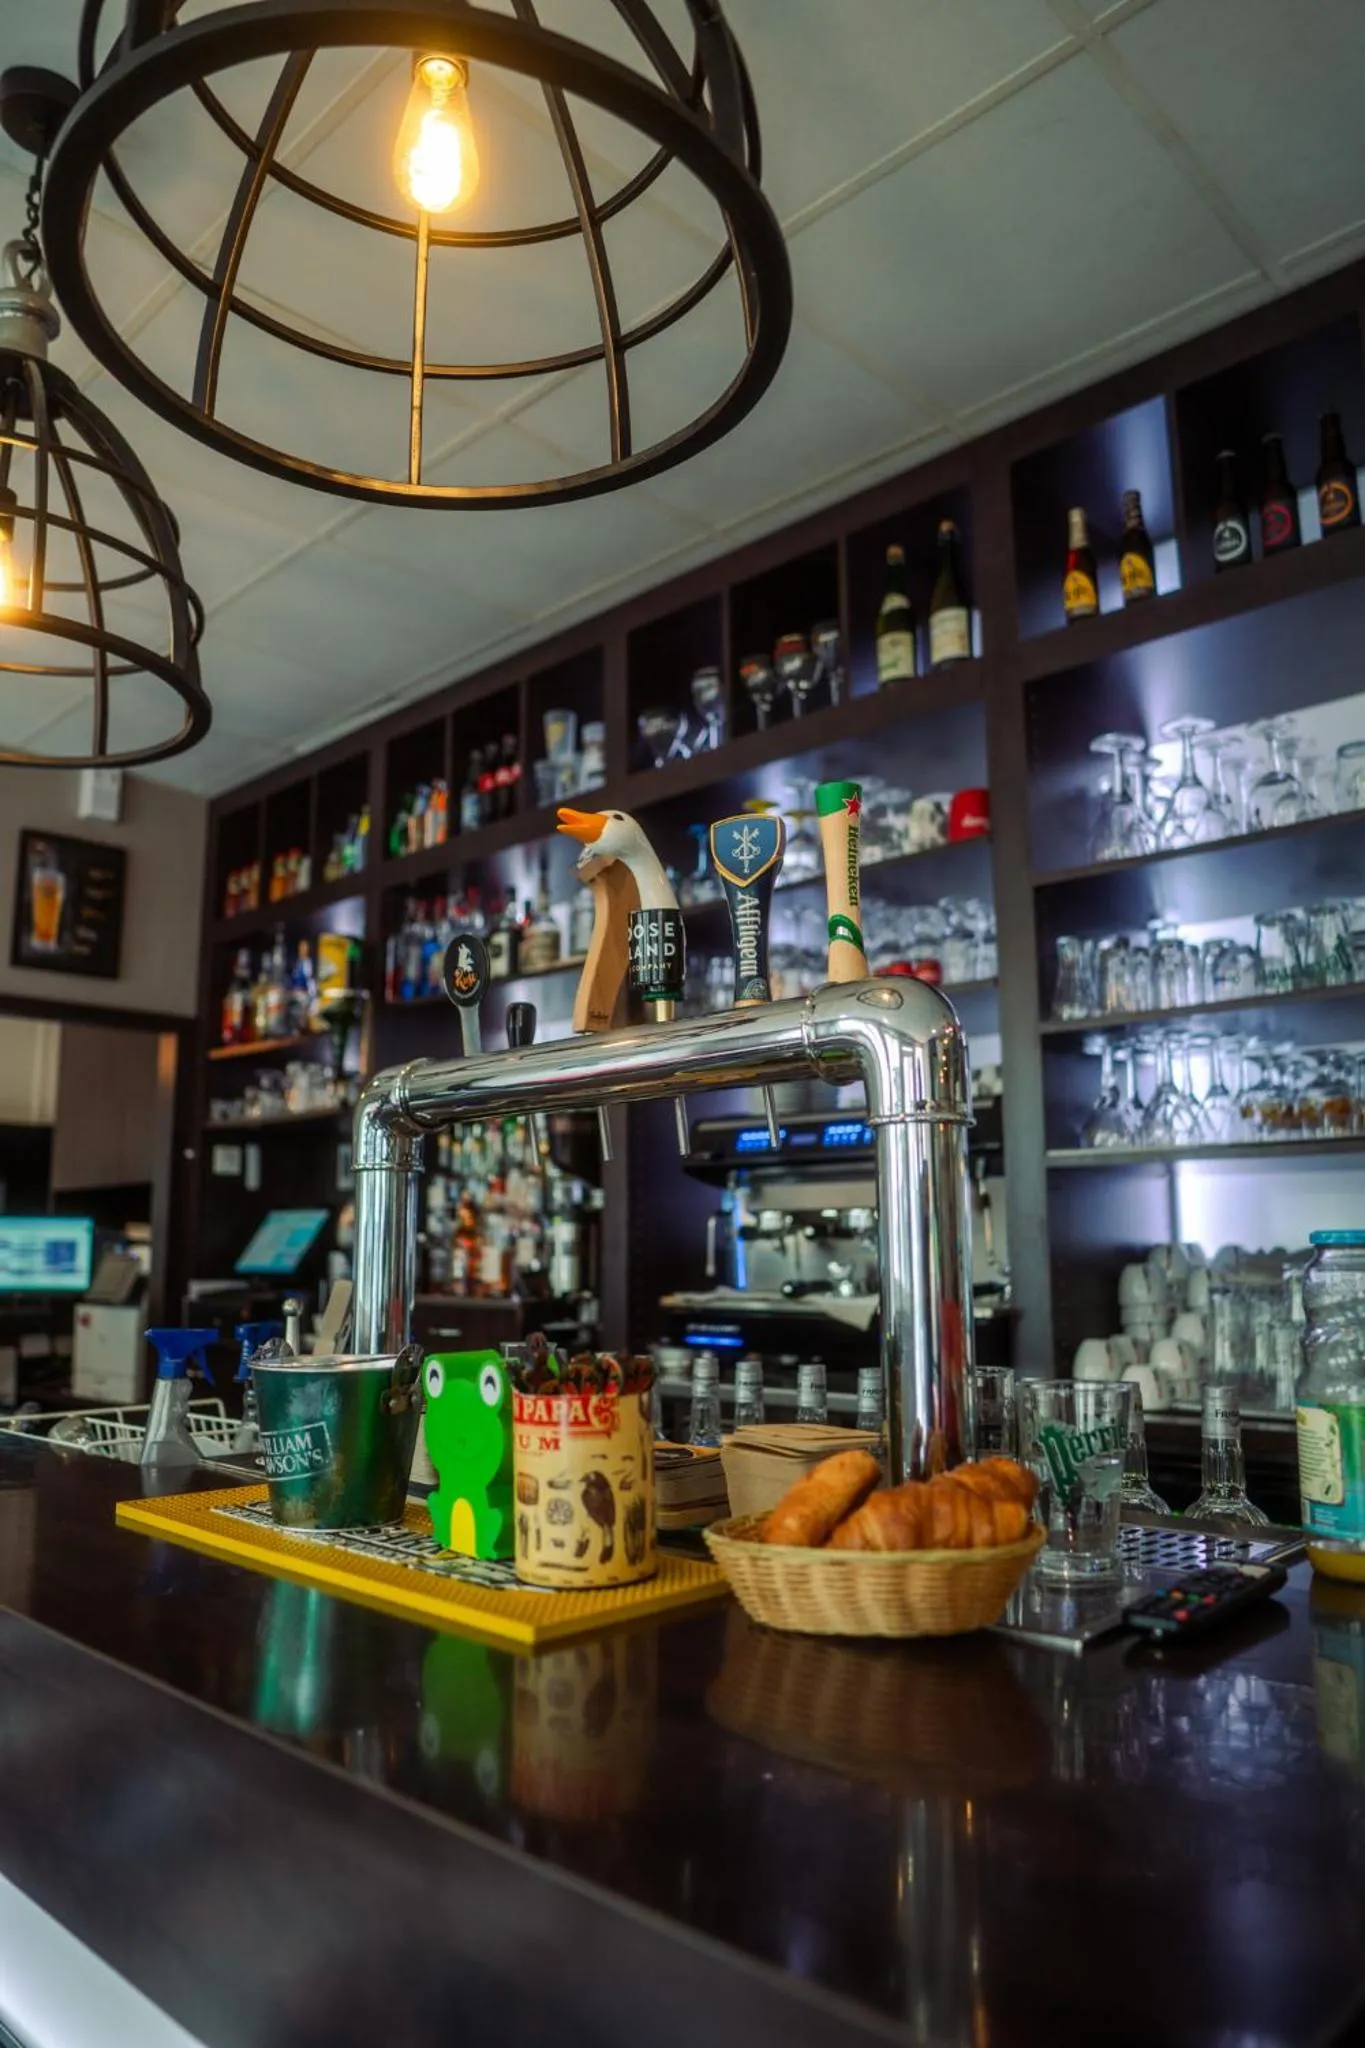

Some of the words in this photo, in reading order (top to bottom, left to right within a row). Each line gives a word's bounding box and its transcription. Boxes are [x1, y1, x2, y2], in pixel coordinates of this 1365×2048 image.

[846, 824, 859, 906] Heineken
[735, 890, 761, 977] Affligem
[264, 1448, 325, 1475] WSON'S
[518, 1434, 560, 1452] UM
[1039, 1418, 1128, 1506] Perrie
